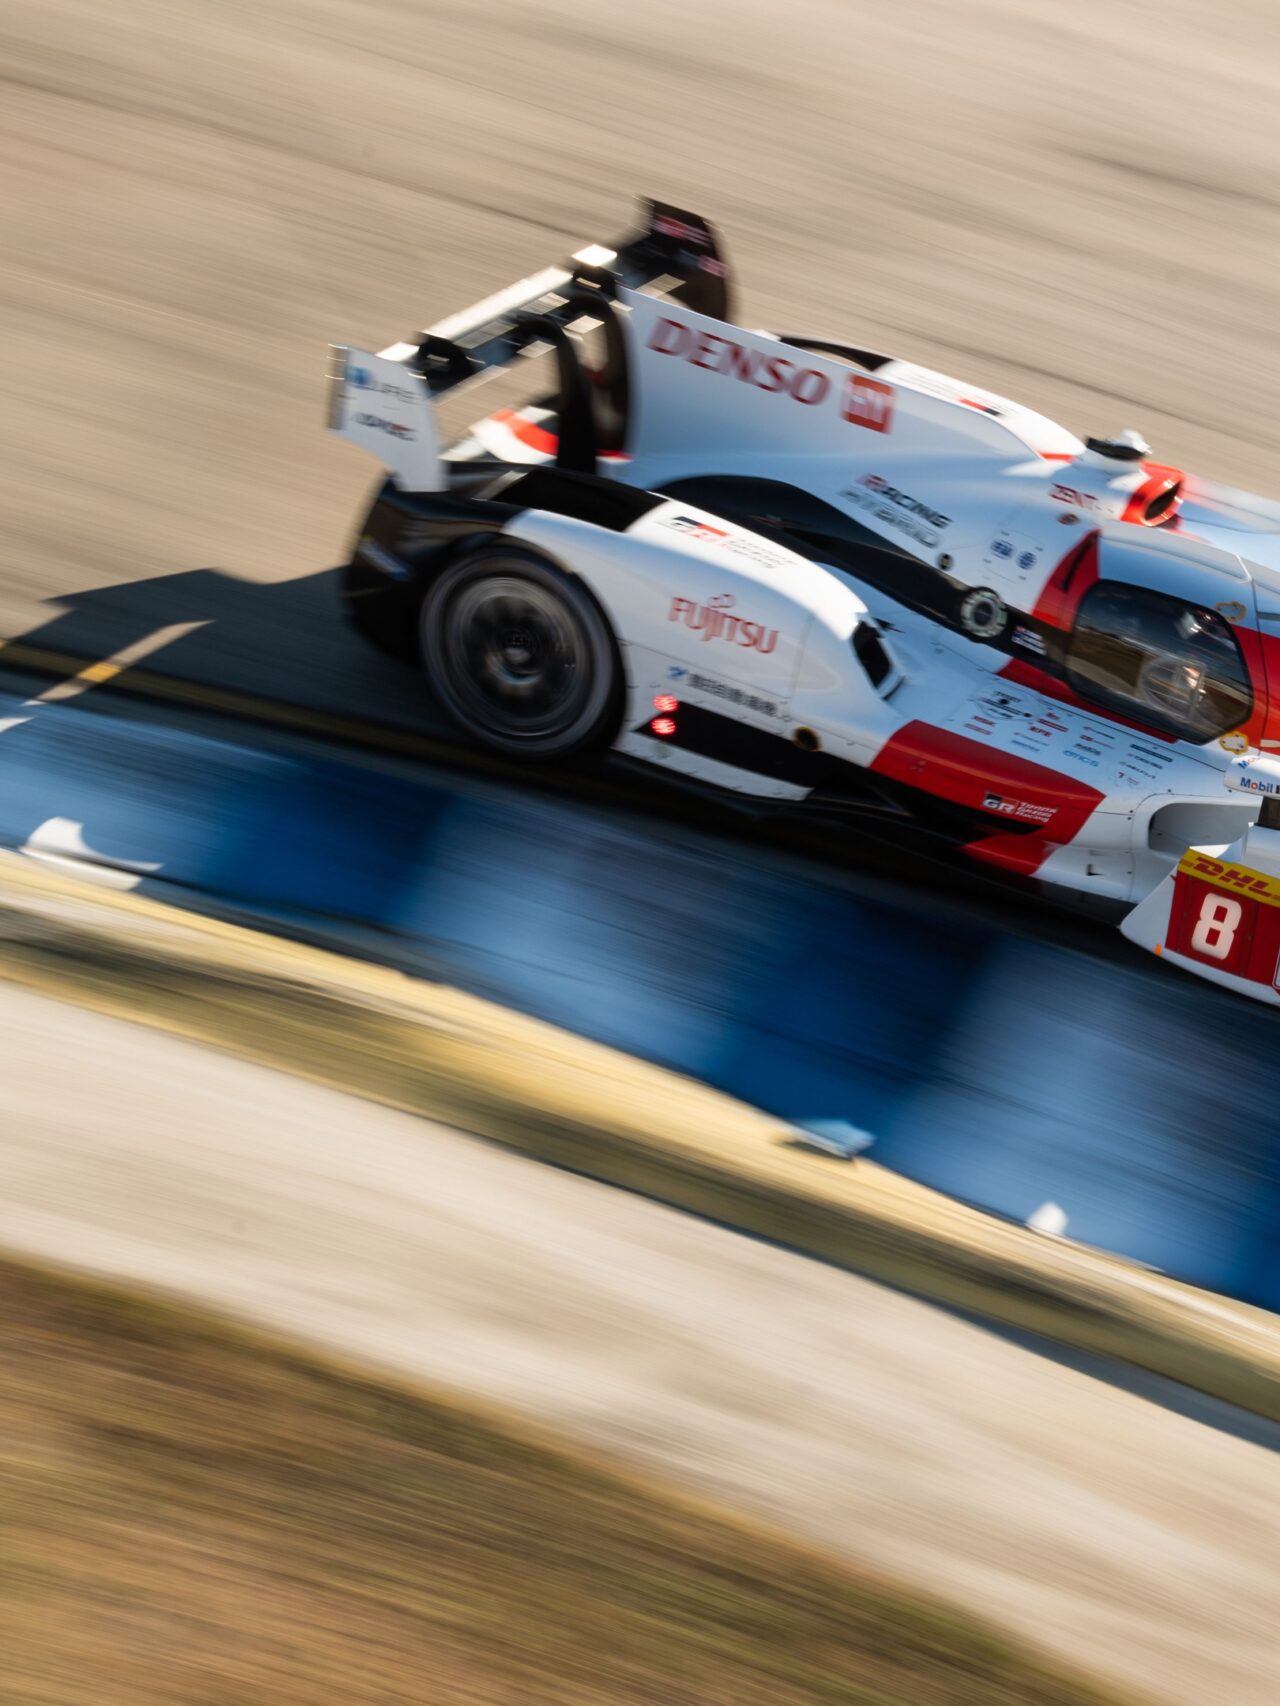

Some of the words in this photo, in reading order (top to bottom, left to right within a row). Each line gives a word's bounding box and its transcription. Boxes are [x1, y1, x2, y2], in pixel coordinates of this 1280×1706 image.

[646, 316, 831, 405] DENSO
[858, 474, 953, 529] RACING
[668, 597, 779, 653] FUJITSU
[983, 798, 1015, 814] GR
[1240, 777, 1273, 793] Mobil
[1193, 857, 1273, 897] DHL
[1191, 892, 1242, 960] 8
